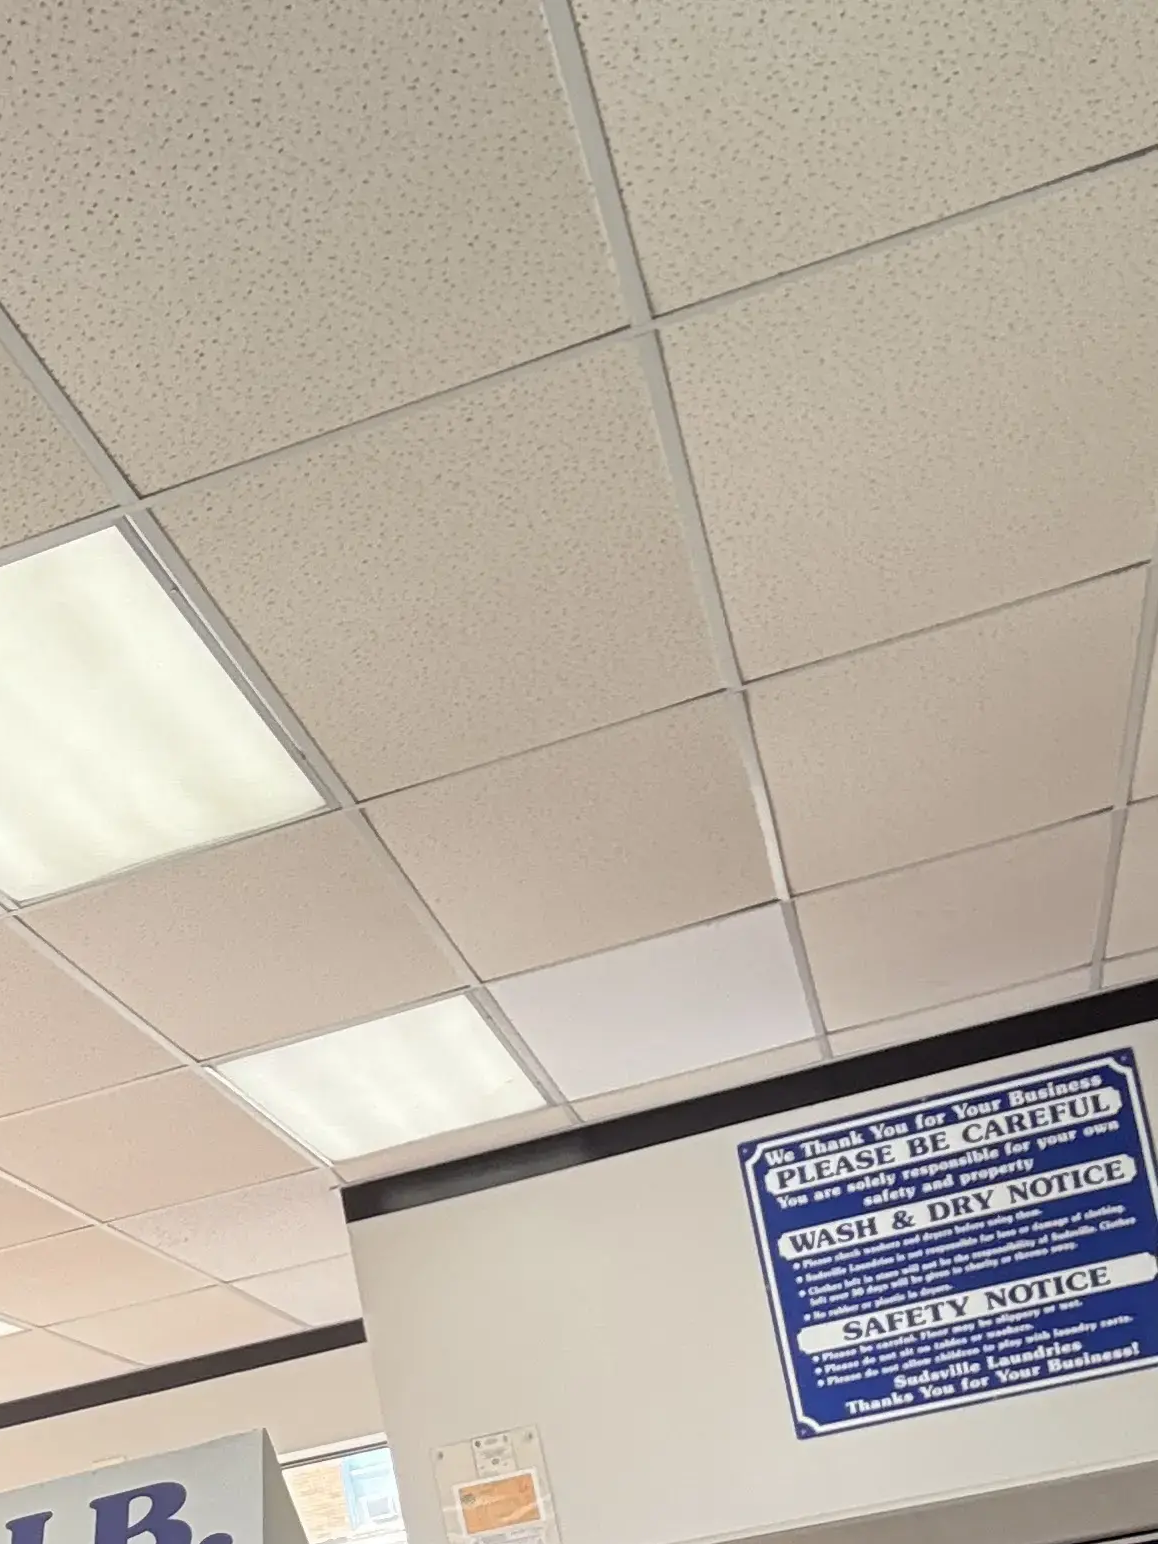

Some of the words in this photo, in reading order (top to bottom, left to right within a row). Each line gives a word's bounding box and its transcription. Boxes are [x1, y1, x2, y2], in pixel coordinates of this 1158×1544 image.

[764, 1148, 795, 1166] We
[799, 1130, 865, 1158] Thank
[868, 1122, 909, 1140] You
[914, 1112, 946, 1130] for
[950, 1098, 1002, 1120] Your
[1007, 1074, 1102, 1107] Business
[776, 1144, 895, 1189] PLEASE
[906, 1130, 950, 1158] BE
[961, 1093, 1110, 1143] CAREFUL
[775, 1194, 809, 1209] You
[813, 1186, 841, 1201] are
[846, 1171, 896, 1193] solely
[901, 1147, 999, 1180] responsible
[1003, 1140, 1030, 1156] for
[1036, 1129, 1077, 1150] your
[1082, 1120, 1120, 1137] own
[862, 1185, 916, 1207] safety
[921, 1173, 954, 1193] and
[958, 1158, 1034, 1187] property
[788, 1216, 879, 1253] WASH
[891, 1210, 916, 1230] &
[926, 1189, 994, 1222] DRY
[1006, 1159, 1125, 1204] NOTICE
[842, 1296, 970, 1341] SAFETY
[984, 1266, 1112, 1310] NOTICE
[844, 1391, 914, 1414] Thanks
[918, 1383, 955, 1399] You
[960, 1376, 990, 1391] for
[994, 1365, 1041, 1383] Your
[1046, 1341, 1140, 1373] Business!
[893, 1361, 981, 1389] Sudsville
[985, 1340, 1083, 1370] Laundries
